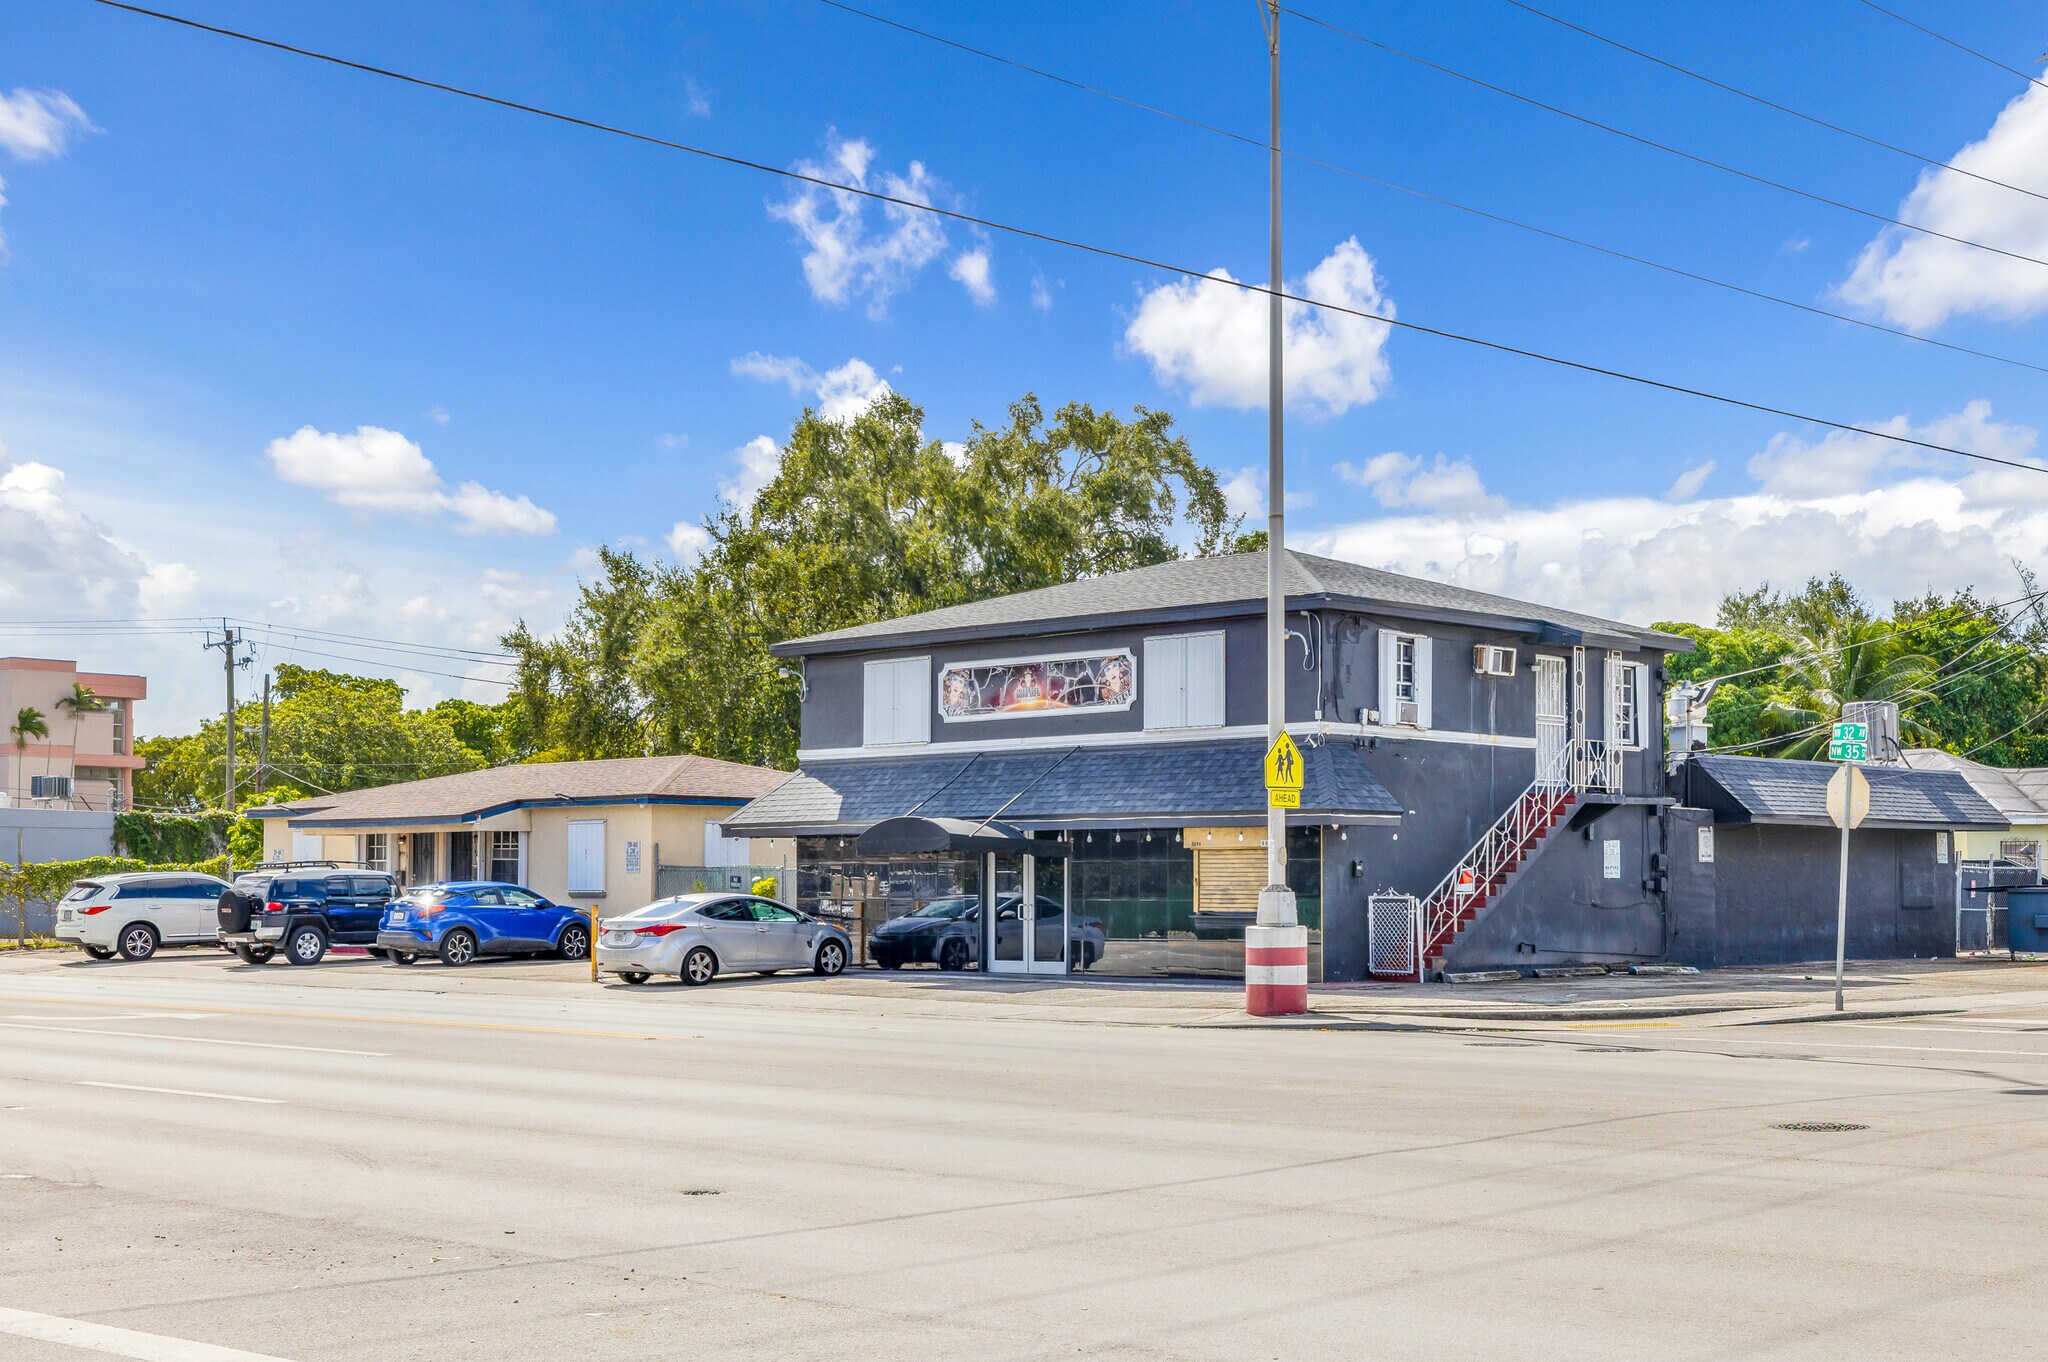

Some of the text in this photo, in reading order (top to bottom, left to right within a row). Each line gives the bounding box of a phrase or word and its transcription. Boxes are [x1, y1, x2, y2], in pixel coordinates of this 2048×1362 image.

[1843, 726, 1855, 740] 32
[1831, 746, 1842, 756] NW
[1844, 744, 1860, 760] 35
[1274, 793, 1296, 803] AHEAD
